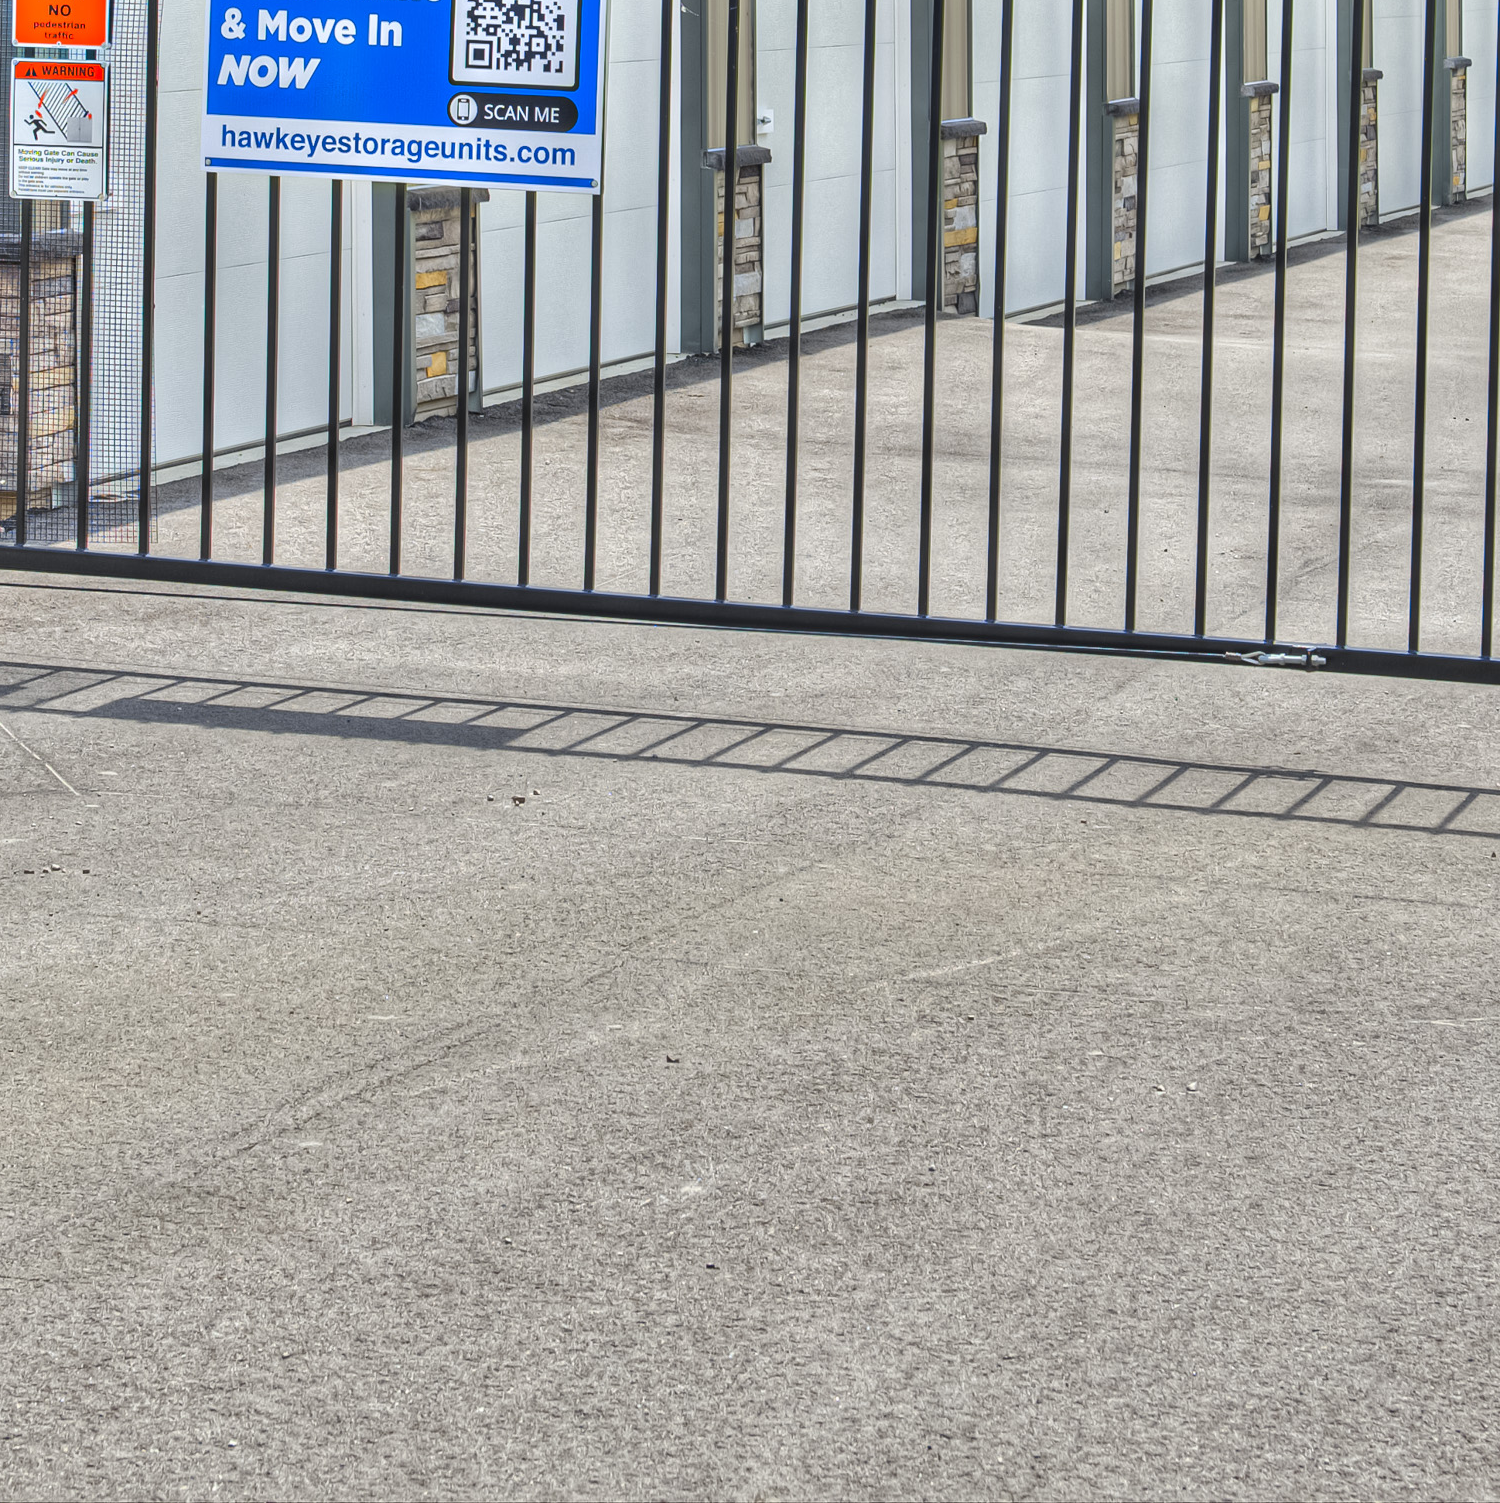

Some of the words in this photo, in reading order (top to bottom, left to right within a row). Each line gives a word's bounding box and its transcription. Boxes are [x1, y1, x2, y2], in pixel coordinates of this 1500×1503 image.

[48, 4, 71, 17] NO
[33, 21, 86, 30] pedestrian
[220, 7, 247, 40] &
[257, 8, 357, 45] Move
[368, 13, 403, 47] In
[44, 31, 74, 40] traffic
[41, 65, 94, 77] WARNING
[216, 53, 322, 90] NOW
[483, 103, 529, 122] SCAN
[534, 106, 560, 123] ME
[221, 124, 575, 166] hawkeyestorageunits.com
[45, 156, 64, 164] Injury
[76, 150, 99, 158] Cause
